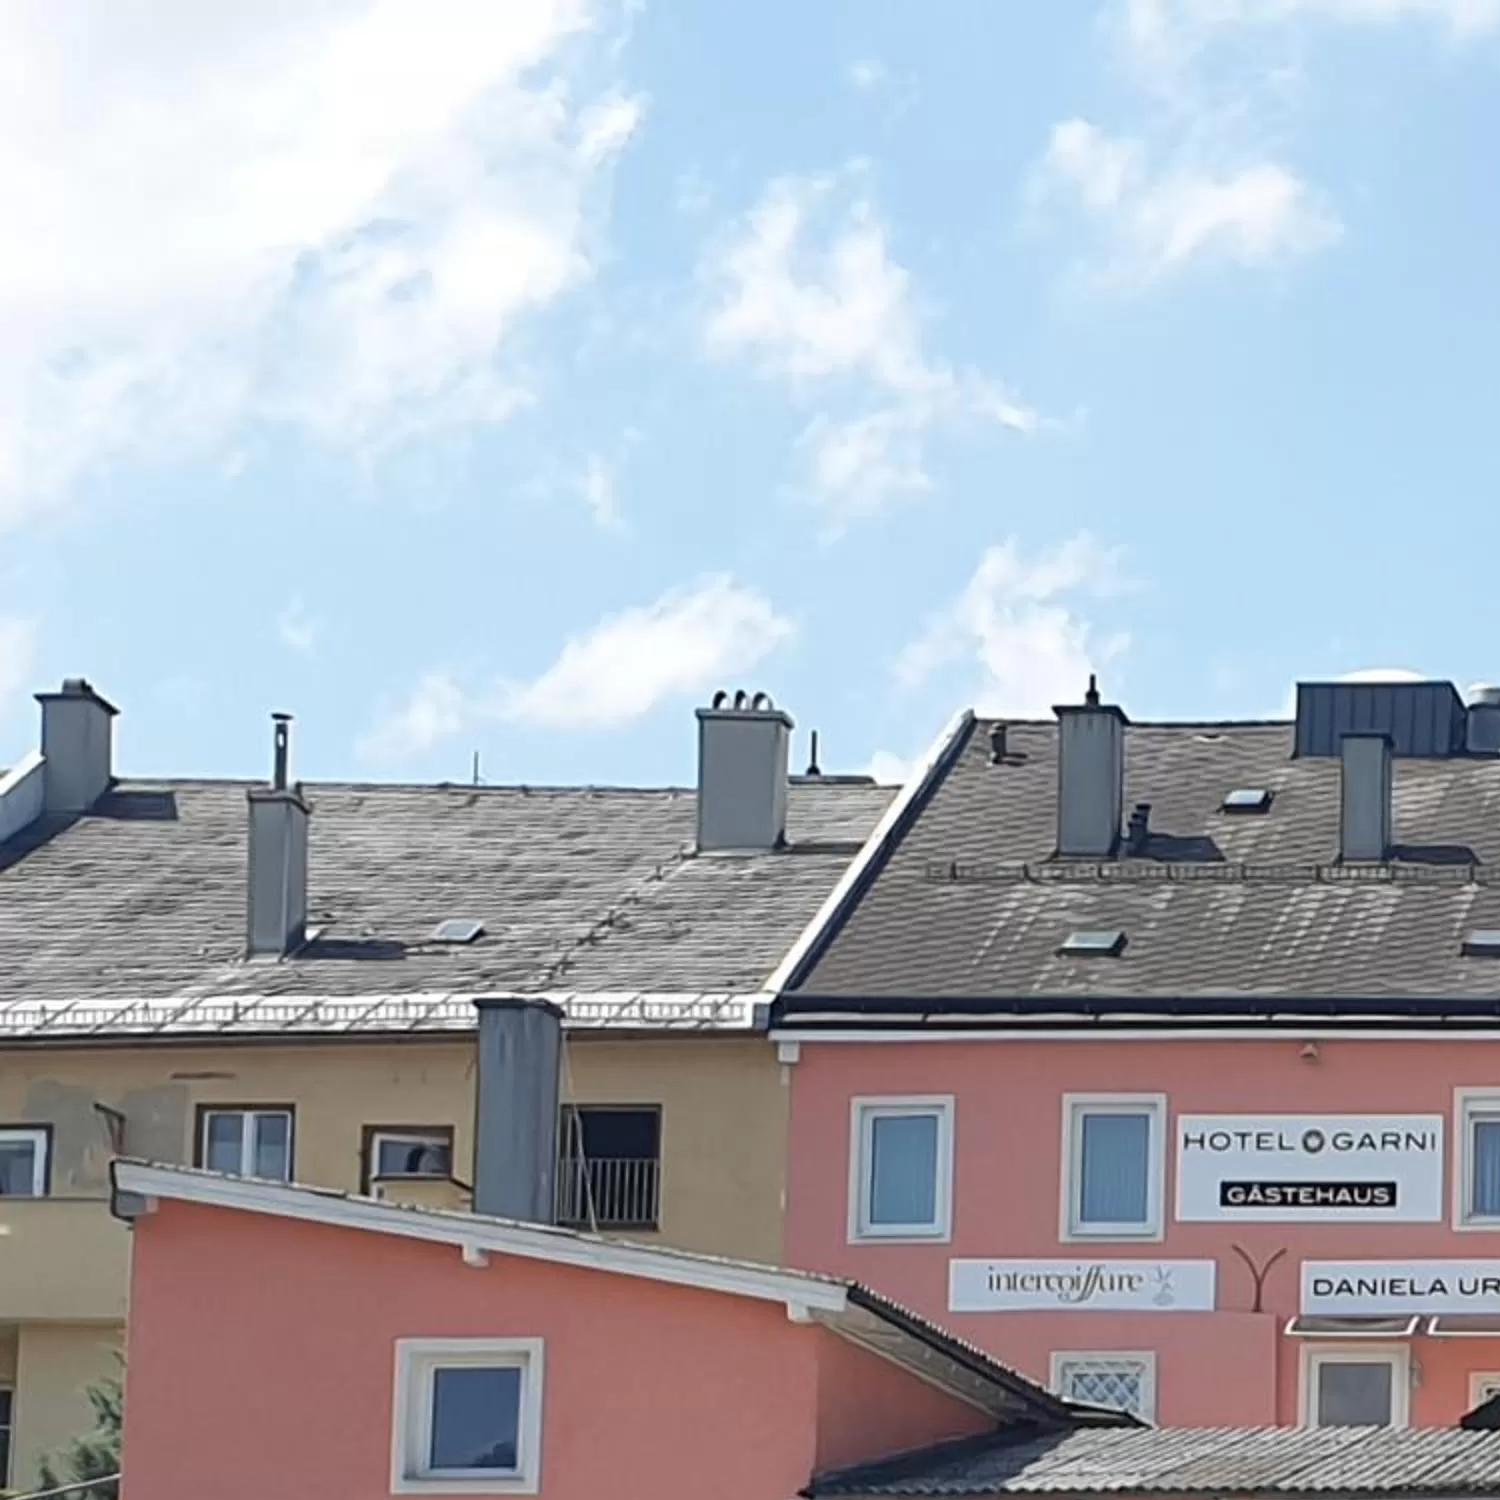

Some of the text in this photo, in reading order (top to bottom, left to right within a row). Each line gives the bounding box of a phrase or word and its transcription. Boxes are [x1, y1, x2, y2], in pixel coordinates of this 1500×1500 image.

[1184, 1132, 1435, 1151] HOTEL GARNI
[1226, 1184, 1390, 1204] GÄSTEHAUS
[988, 1264, 1143, 1304] intercoiffure
[1313, 1278, 1448, 1297] DANIELA
